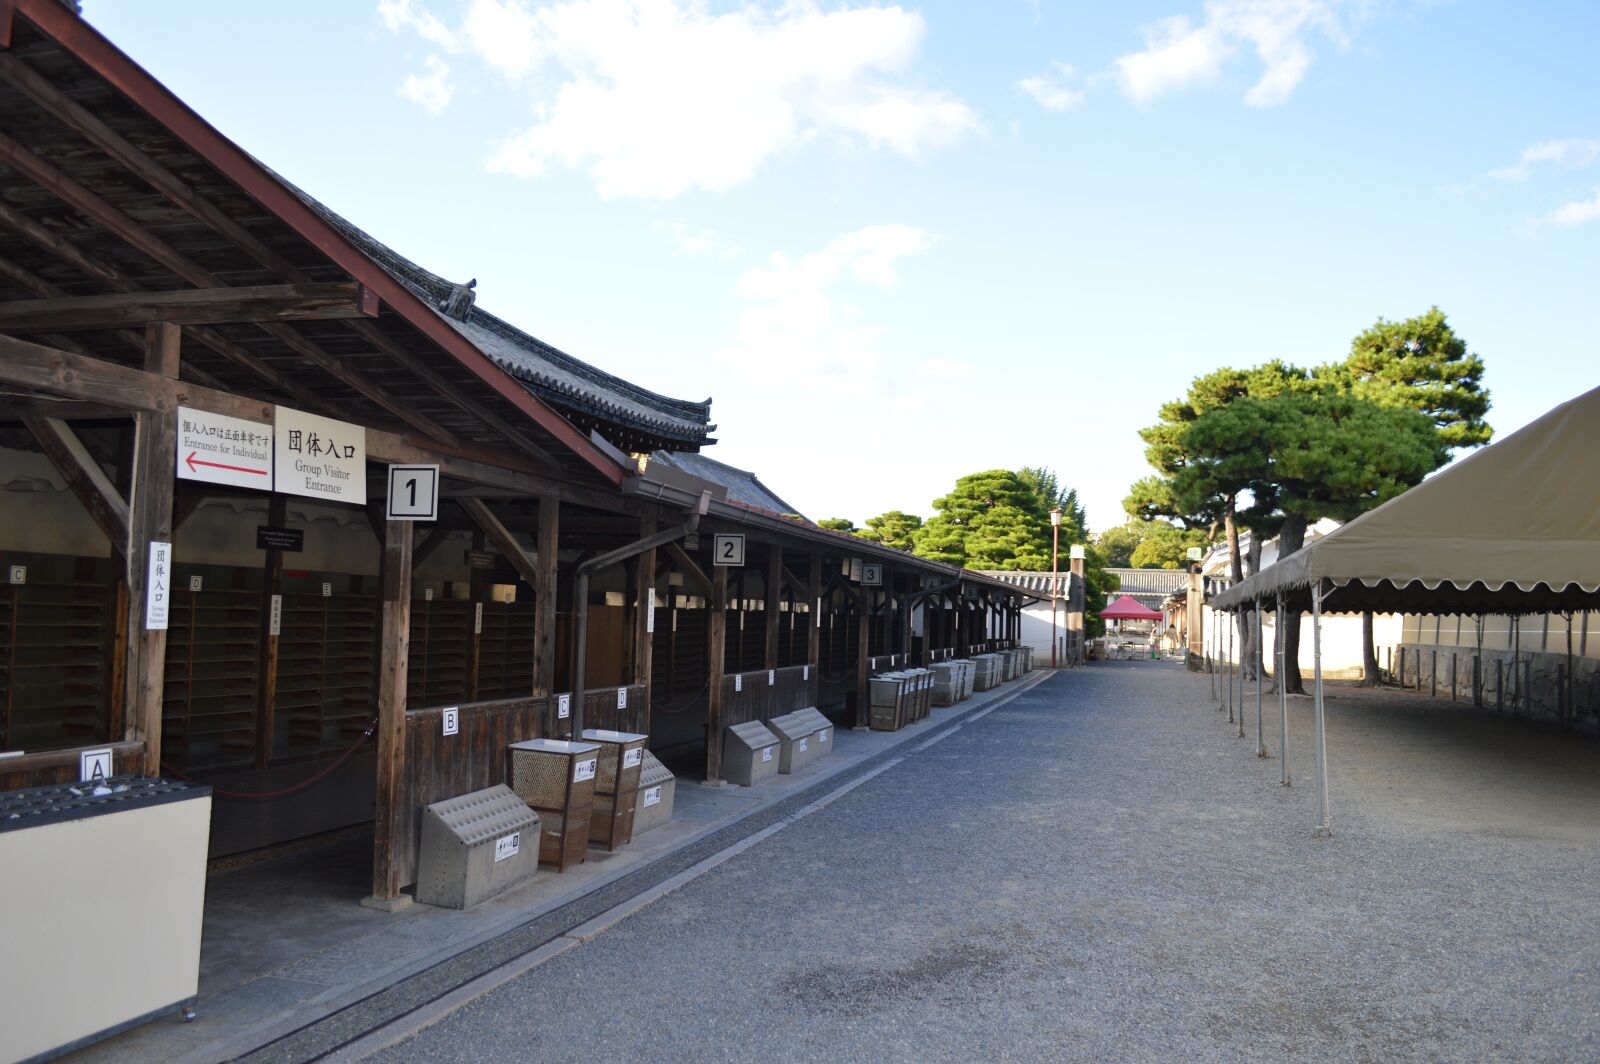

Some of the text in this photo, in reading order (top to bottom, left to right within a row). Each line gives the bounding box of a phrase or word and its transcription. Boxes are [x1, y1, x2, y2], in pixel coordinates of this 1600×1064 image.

[184, 437, 268, 461] Entrance for Individual
[288, 429, 356, 459] 団体入口
[295, 459, 351, 480] Group Visitor
[305, 477, 342, 495] Entrance
[406, 478, 417, 507] 1
[723, 541, 734, 558] 2
[15, 569, 22, 580] C
[155, 550, 165, 602] 団体入口
[867, 569, 875, 581] 3
[561, 700, 567, 713] C
[447, 713, 455, 729] B
[92, 759, 105, 782] A
